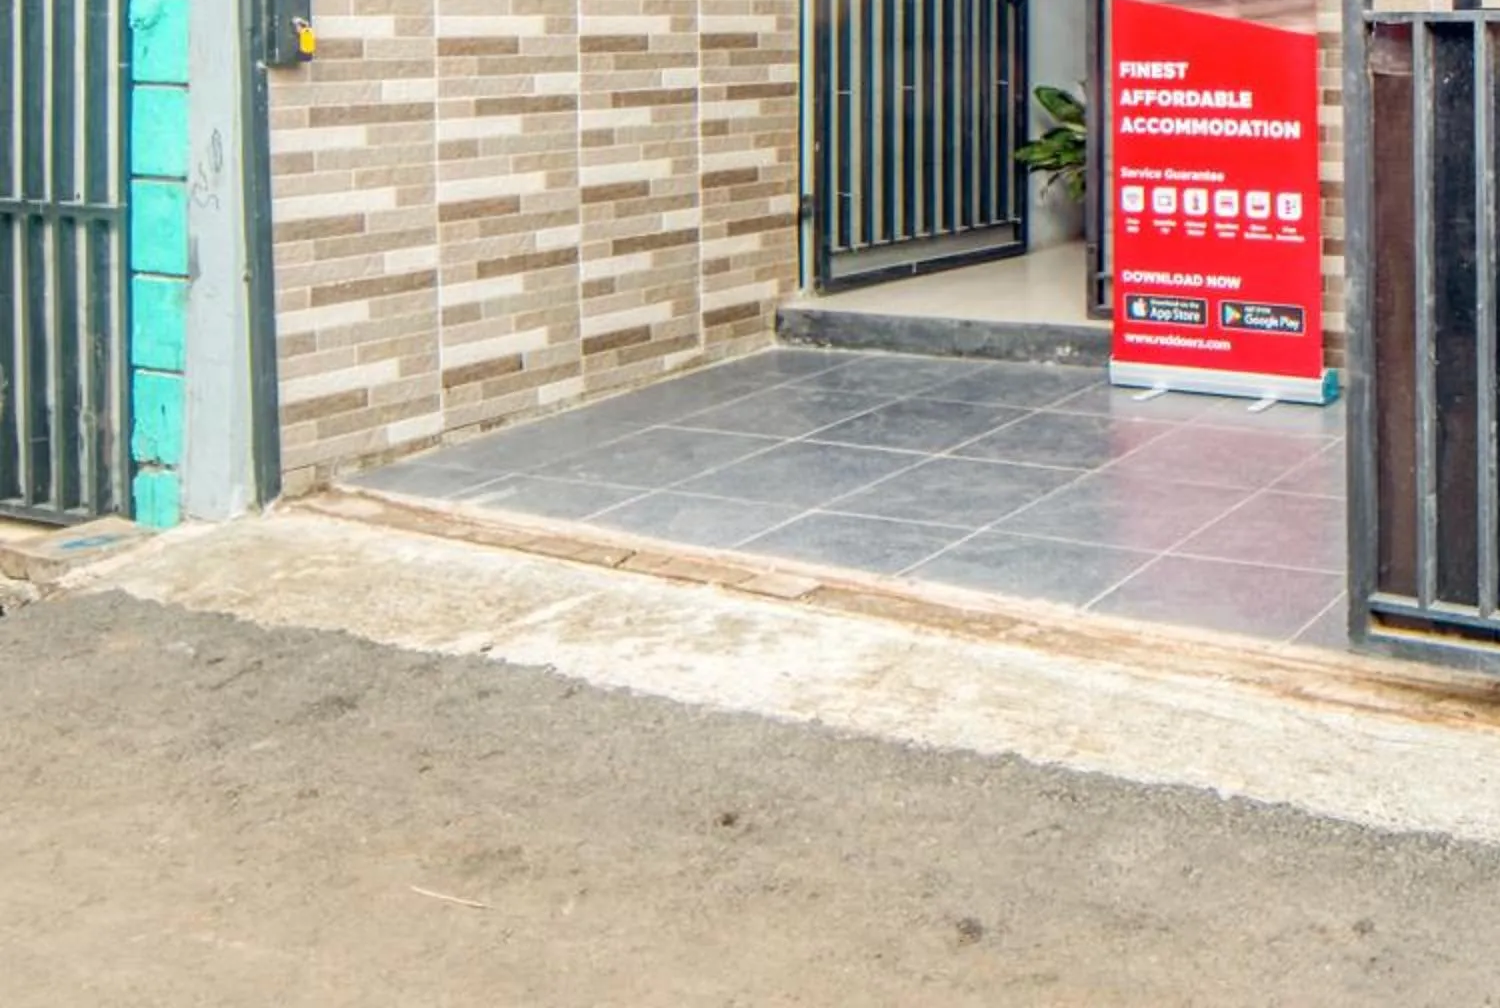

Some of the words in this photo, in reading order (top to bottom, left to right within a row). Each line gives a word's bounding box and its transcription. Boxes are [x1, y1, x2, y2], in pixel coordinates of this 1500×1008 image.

[1119, 61, 1189, 79] FINEST
[1119, 88, 1253, 109] AFFORDABLE
[1120, 116, 1301, 139] ACCOMMODATION
[1120, 166, 1162, 179] Service
[1164, 167, 1226, 182] Guarantee
[1121, 270, 1204, 287] DOWNLOAD
[1205, 275, 1242, 289] NOW
[1150, 306, 1173, 321] App
[1173, 307, 1201, 323] Store
[1243, 313, 1279, 329] Google
[1279, 315, 1300, 331] Play
